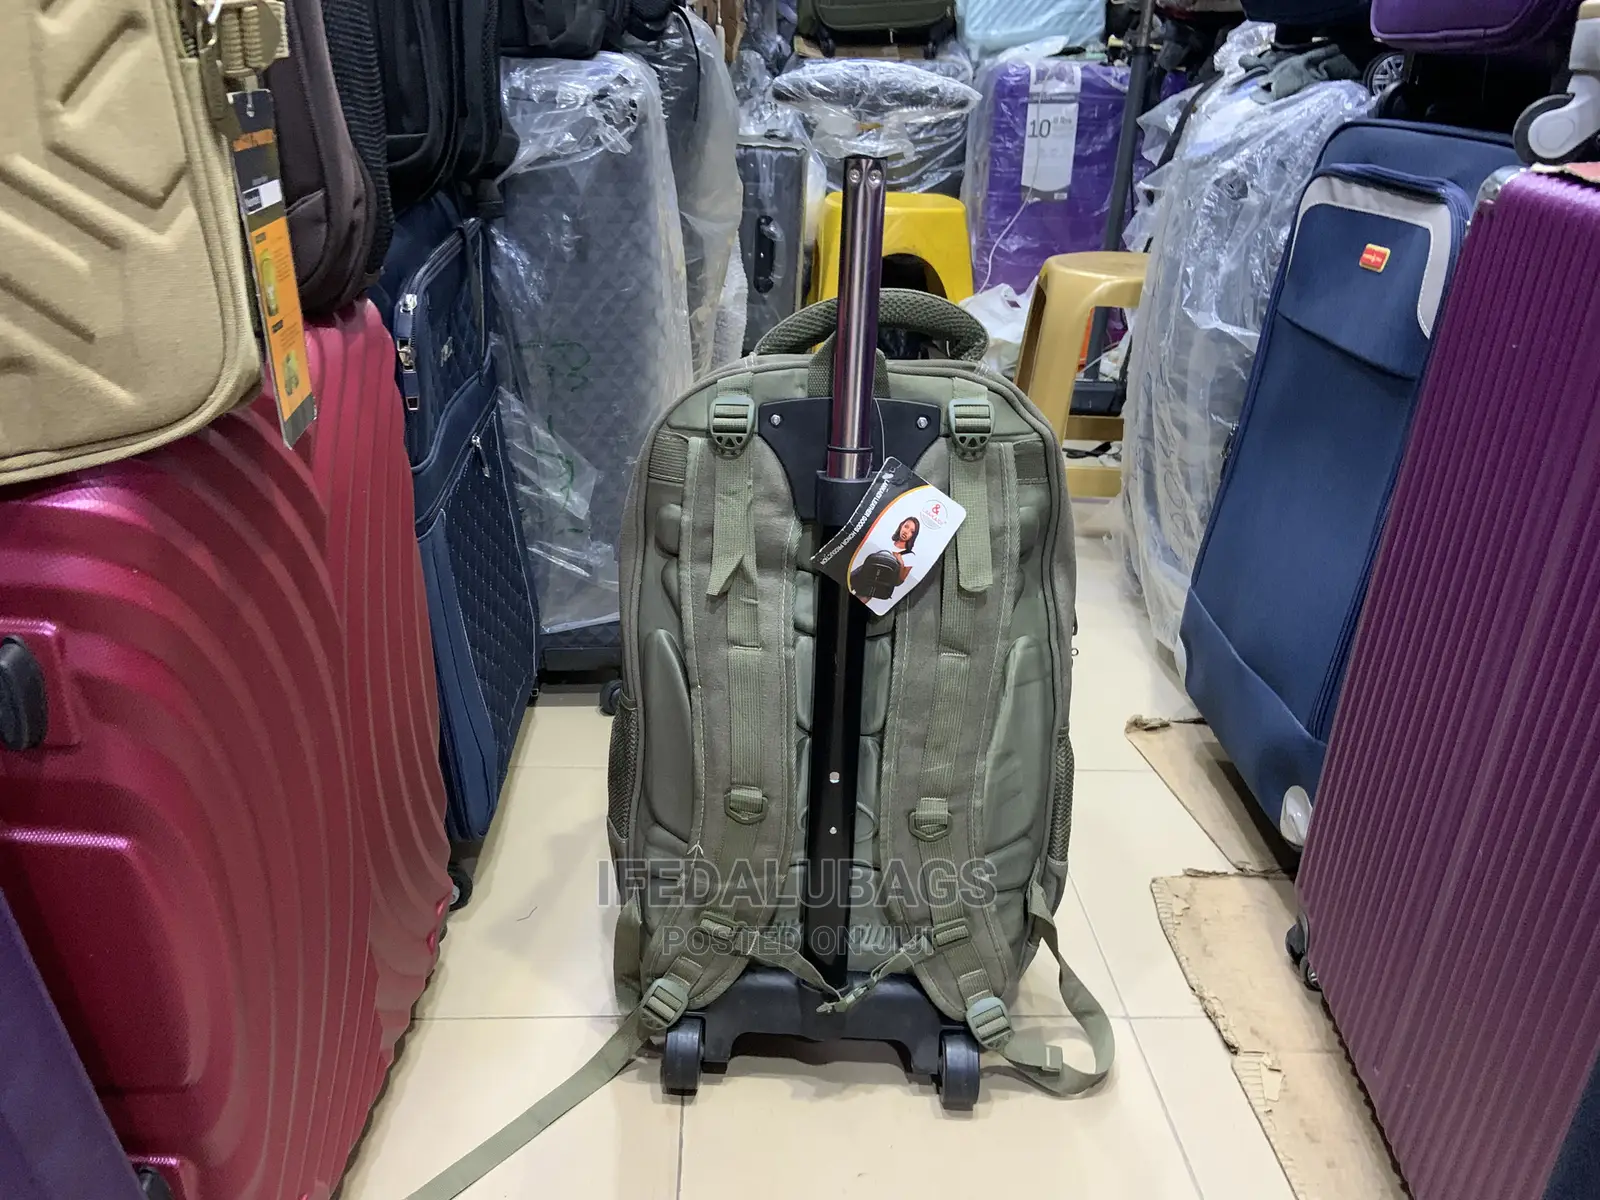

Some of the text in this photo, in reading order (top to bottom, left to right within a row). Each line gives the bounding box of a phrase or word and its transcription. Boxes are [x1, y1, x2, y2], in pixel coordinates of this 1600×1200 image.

[1028, 119, 1051, 138] 10
[865, 498, 878, 517] LEATHER
[854, 516, 867, 532] GOODS
[820, 545, 843, 565] PRODUCTION
